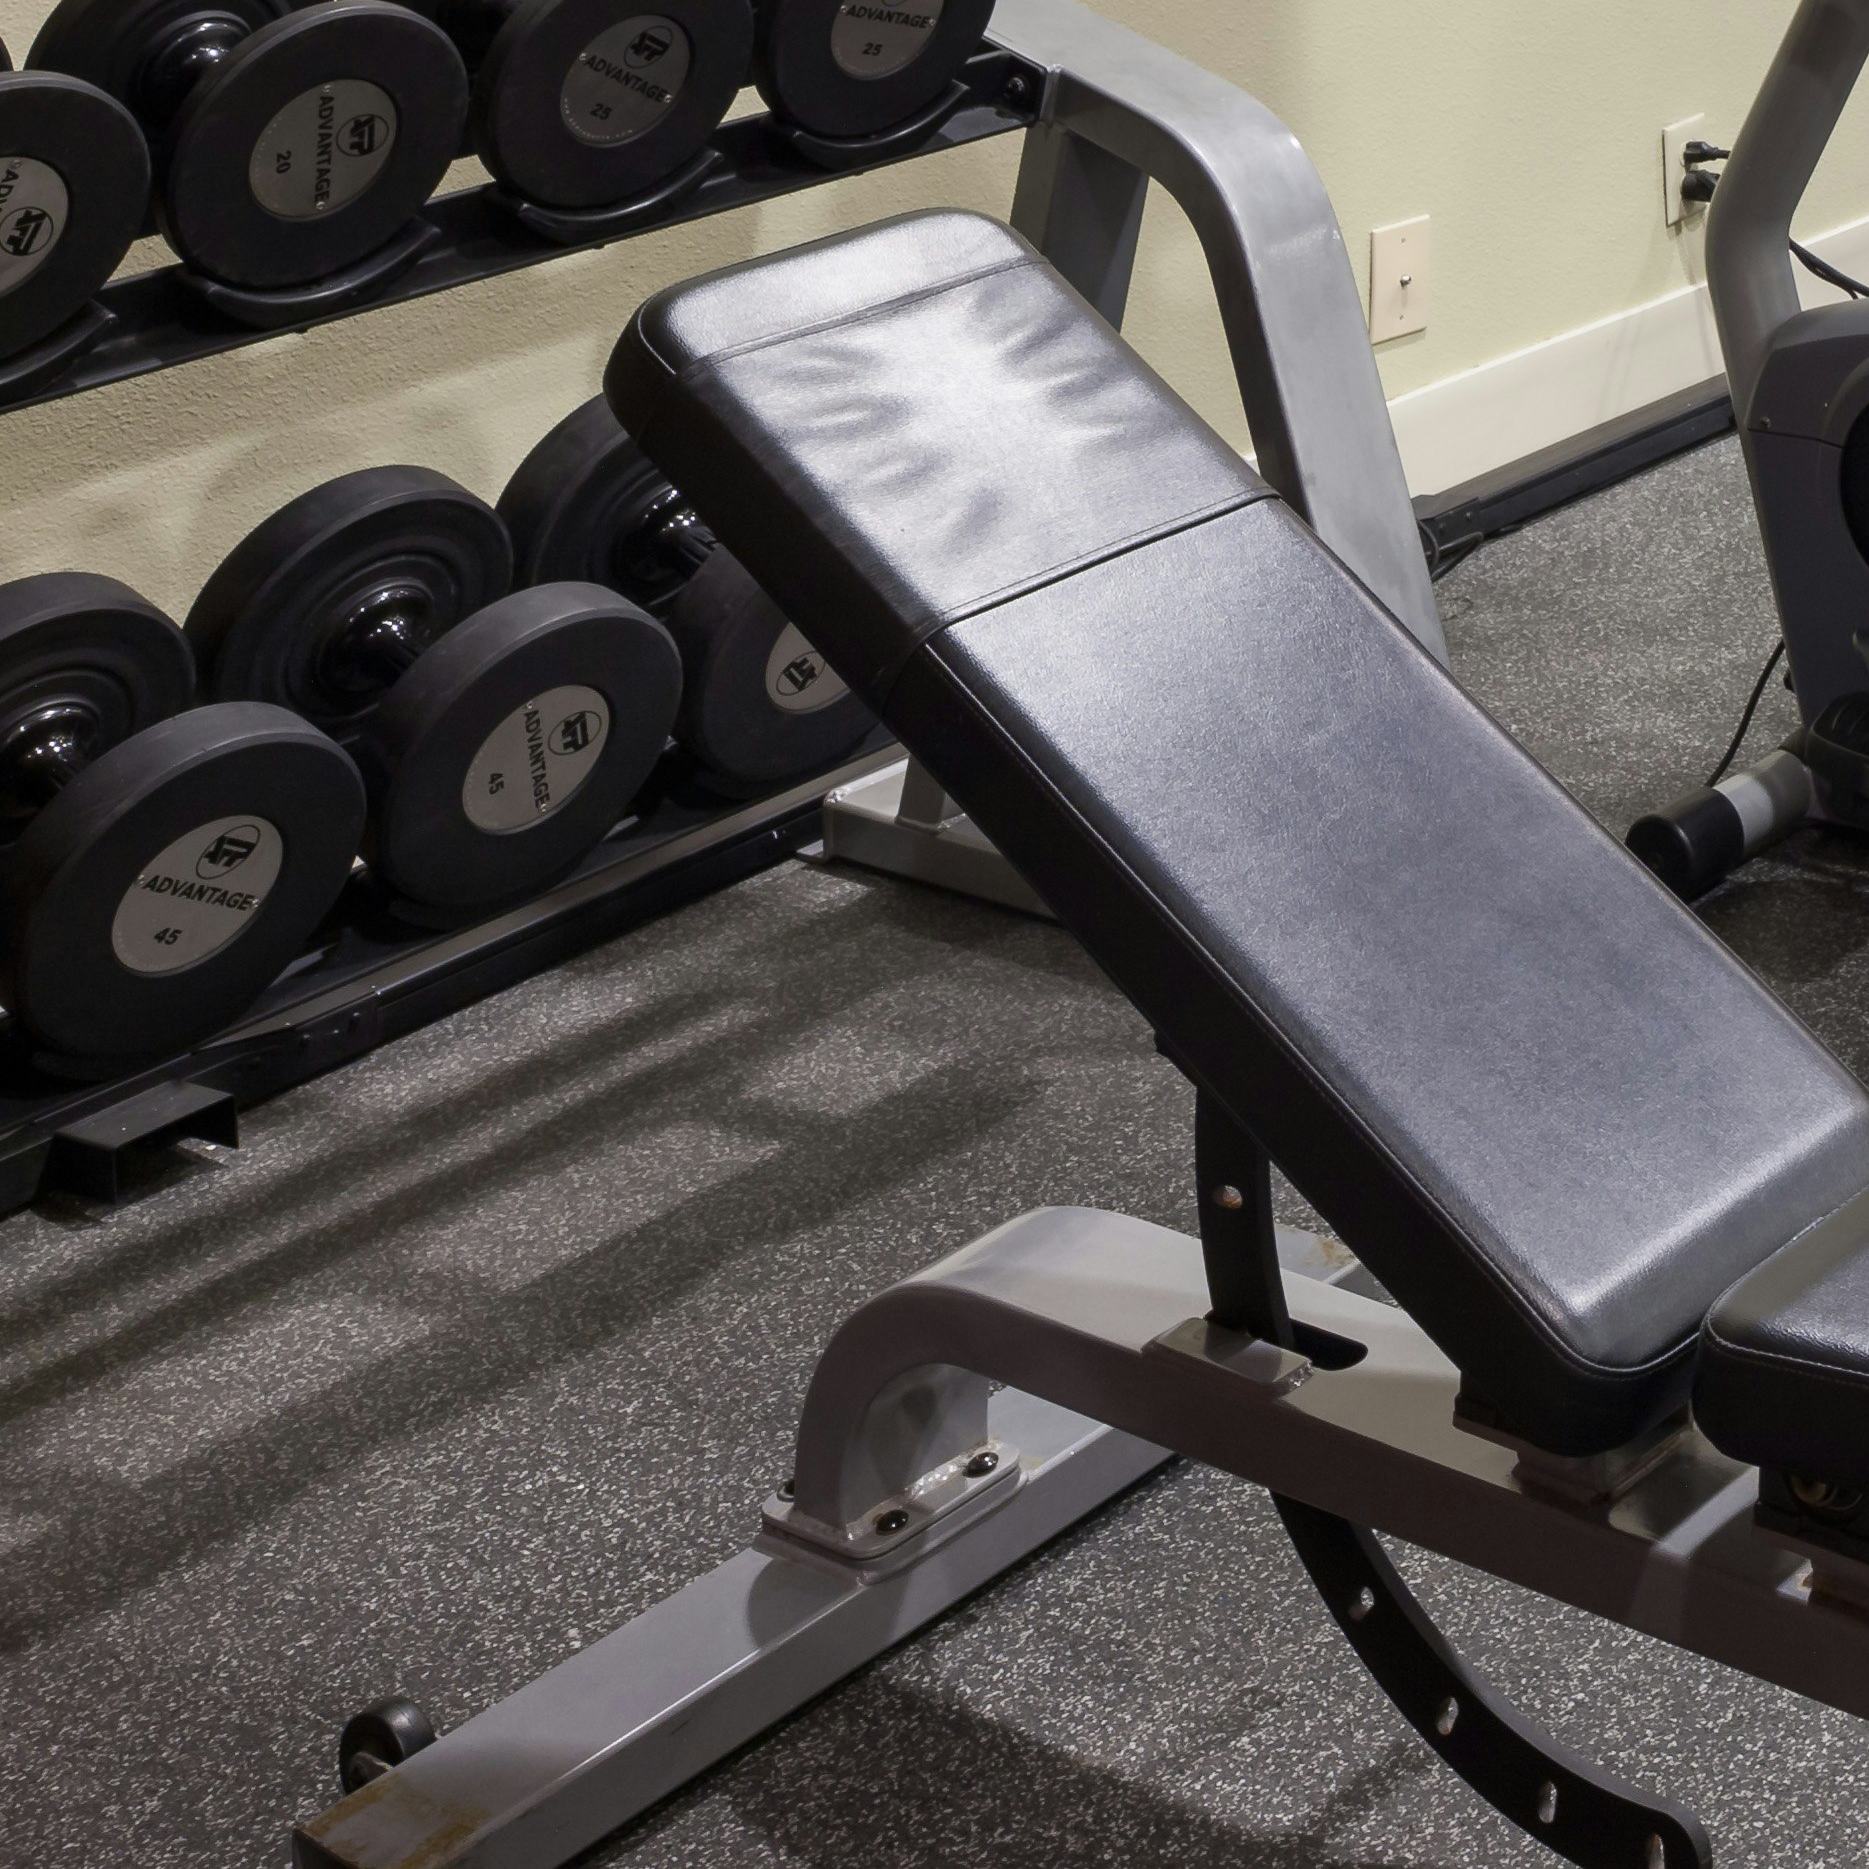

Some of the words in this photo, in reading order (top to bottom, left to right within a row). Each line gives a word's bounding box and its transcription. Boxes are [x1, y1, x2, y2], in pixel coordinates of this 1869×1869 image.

[845, 4, 931, 29] ADVANTAGE
[861, 42, 883, 56] 25
[585, 54, 669, 103] ADVANTAGE
[590, 103, 613, 120] 25
[313, 95, 336, 203] ADVANTAGE
[275, 150, 292, 174] 20
[523, 709, 551, 809] ADVANTAGE
[488, 772, 505, 795] 45
[142, 874, 256, 912] ADVANTAGE
[153, 927, 183, 946] 45
